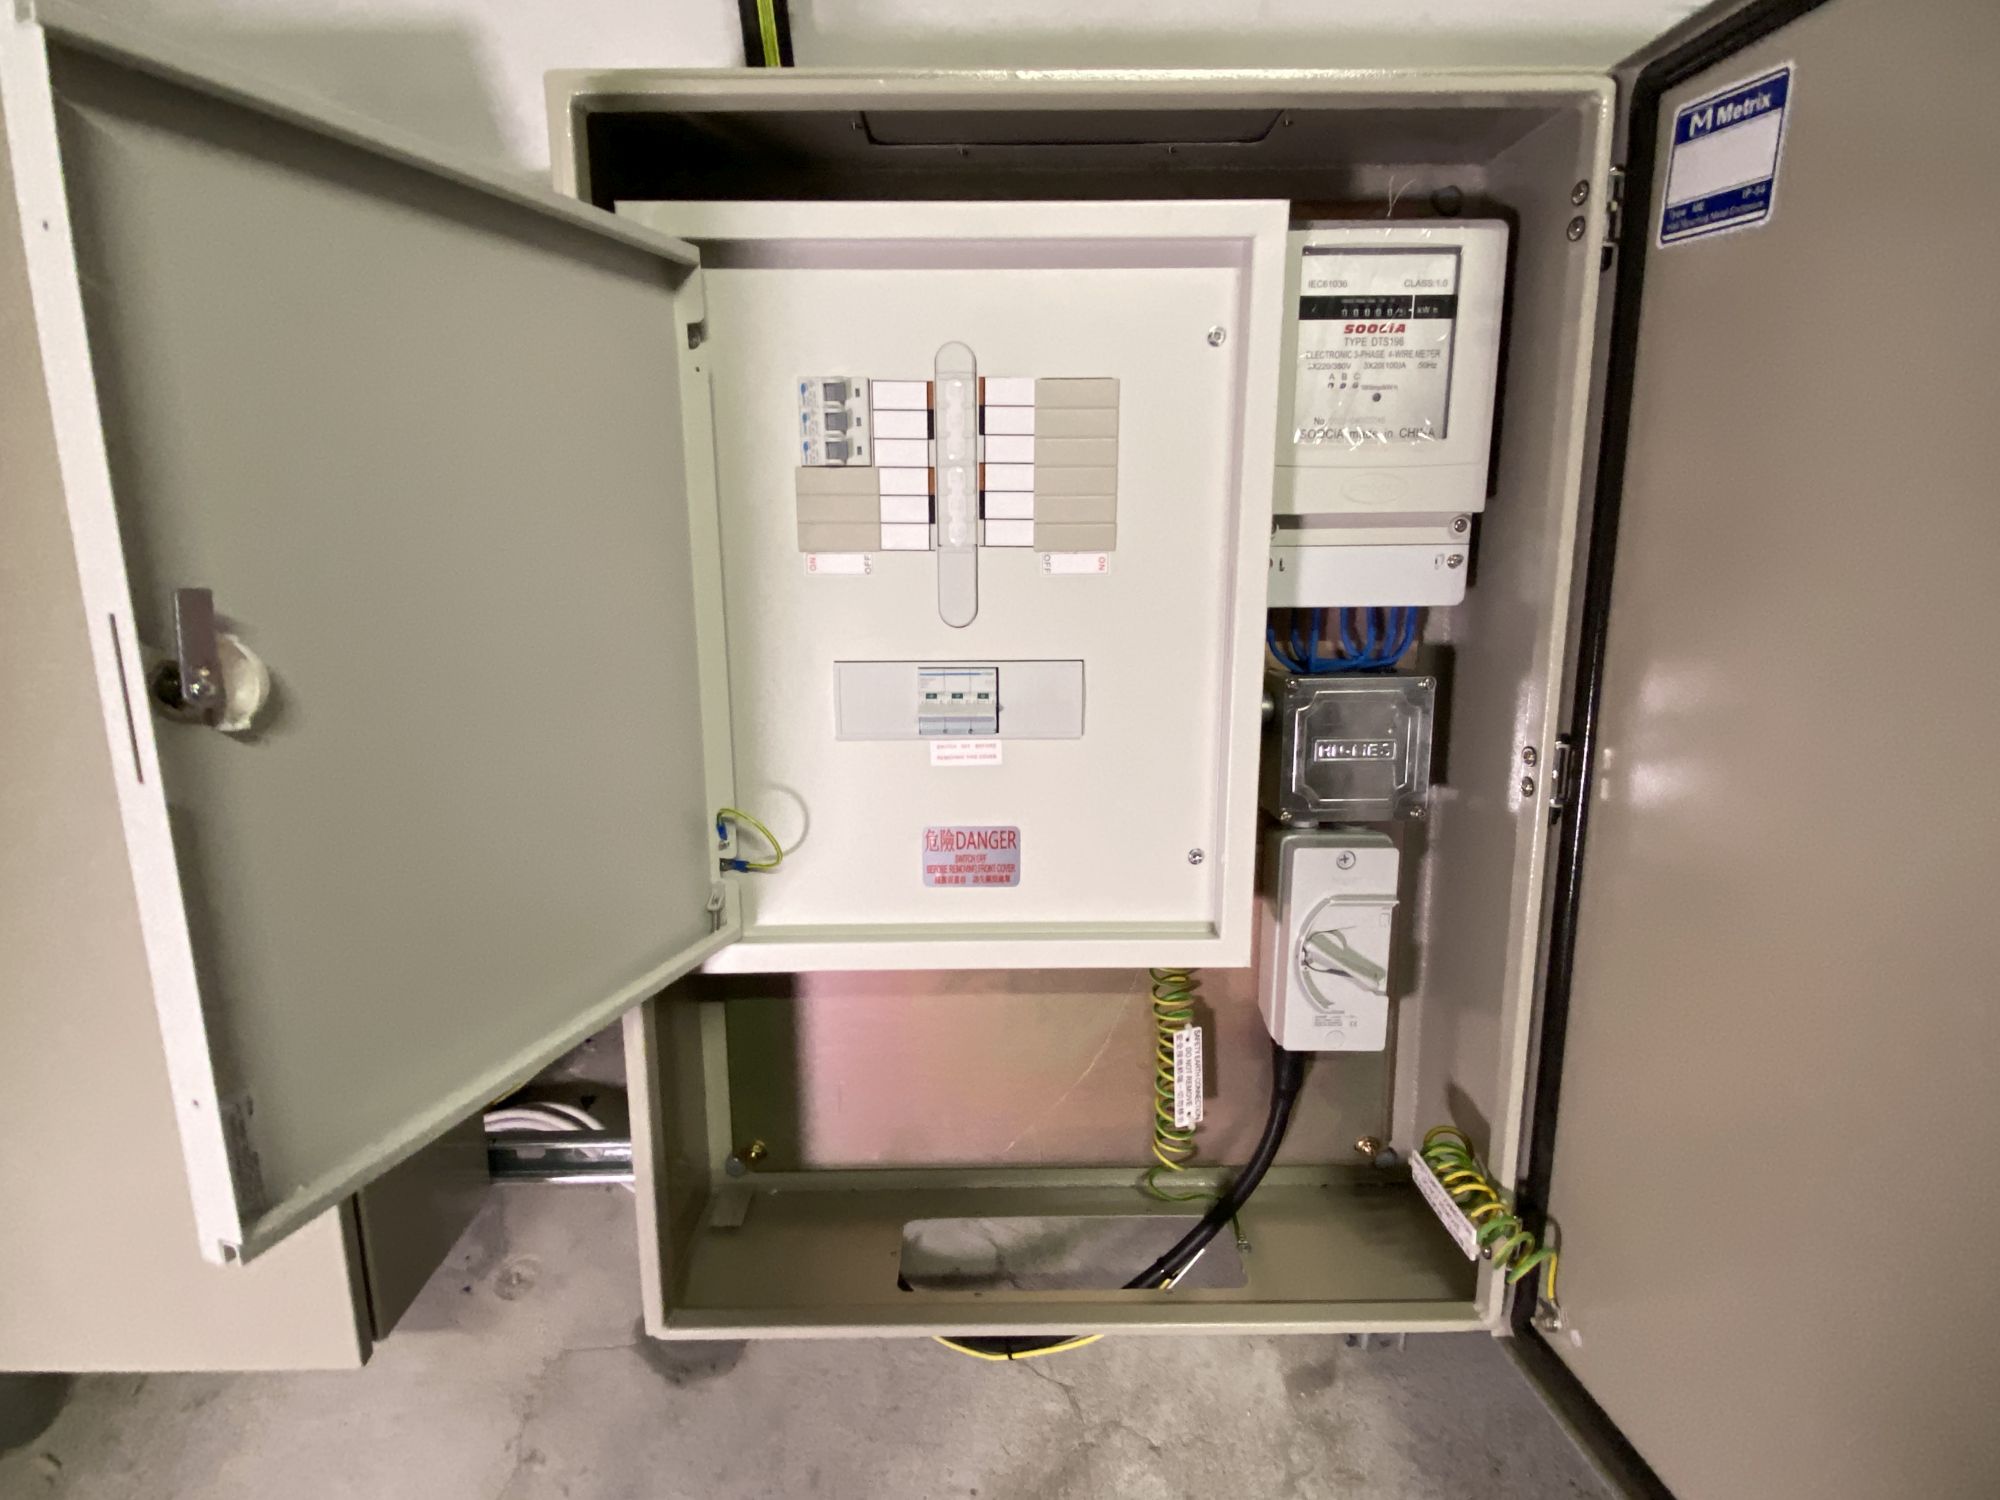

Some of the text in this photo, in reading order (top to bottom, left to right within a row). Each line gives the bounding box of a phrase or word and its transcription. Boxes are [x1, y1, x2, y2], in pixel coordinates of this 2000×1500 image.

[1716, 92, 1771, 126] Metrix
[1345, 336, 1368, 347] TYPE
[808, 556, 817, 572] ON
[864, 553, 872, 575] OFF
[1098, 556, 1106, 571] ON
[925, 829, 1017, 852] 危險 DANGER
[1185, 1047, 1192, 1058] DO
